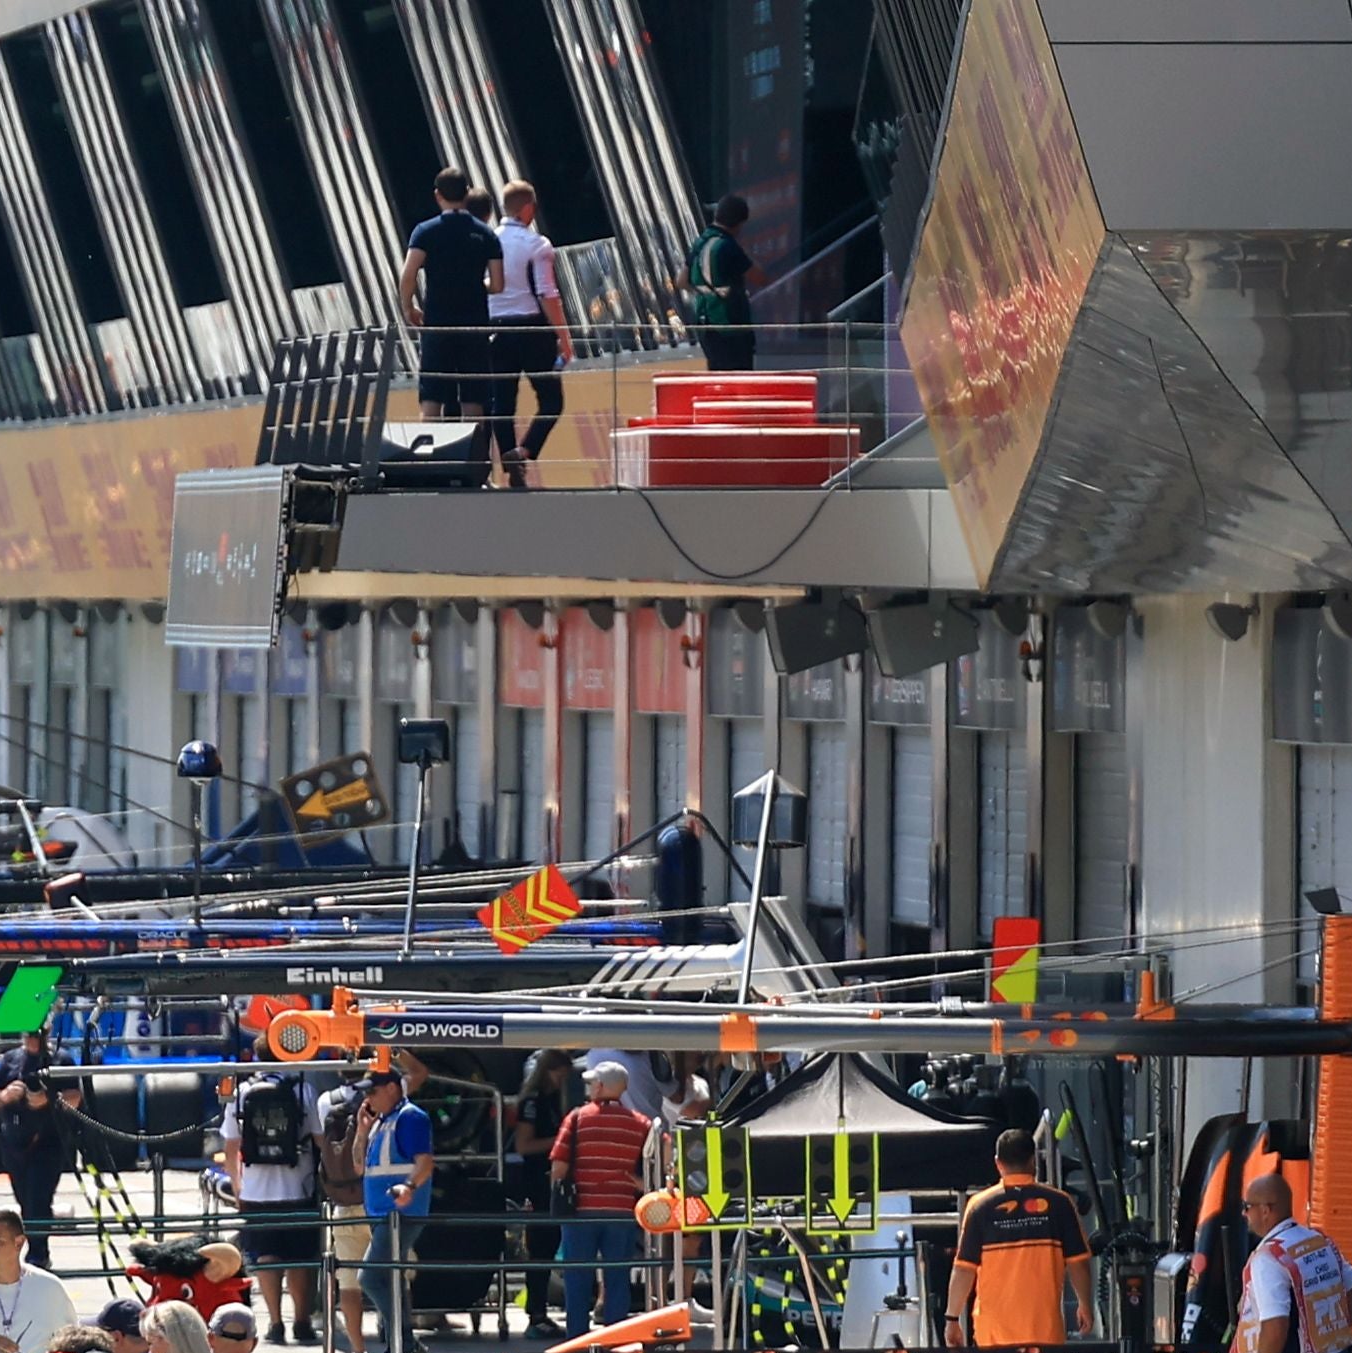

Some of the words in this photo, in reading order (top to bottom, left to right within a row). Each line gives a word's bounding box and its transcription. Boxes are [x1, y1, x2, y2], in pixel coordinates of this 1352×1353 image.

[138, 930, 189, 939] ORACLE
[286, 967, 383, 984] Einhell
[402, 1023, 426, 1037] DP
[430, 1024, 500, 1039] WORLD
